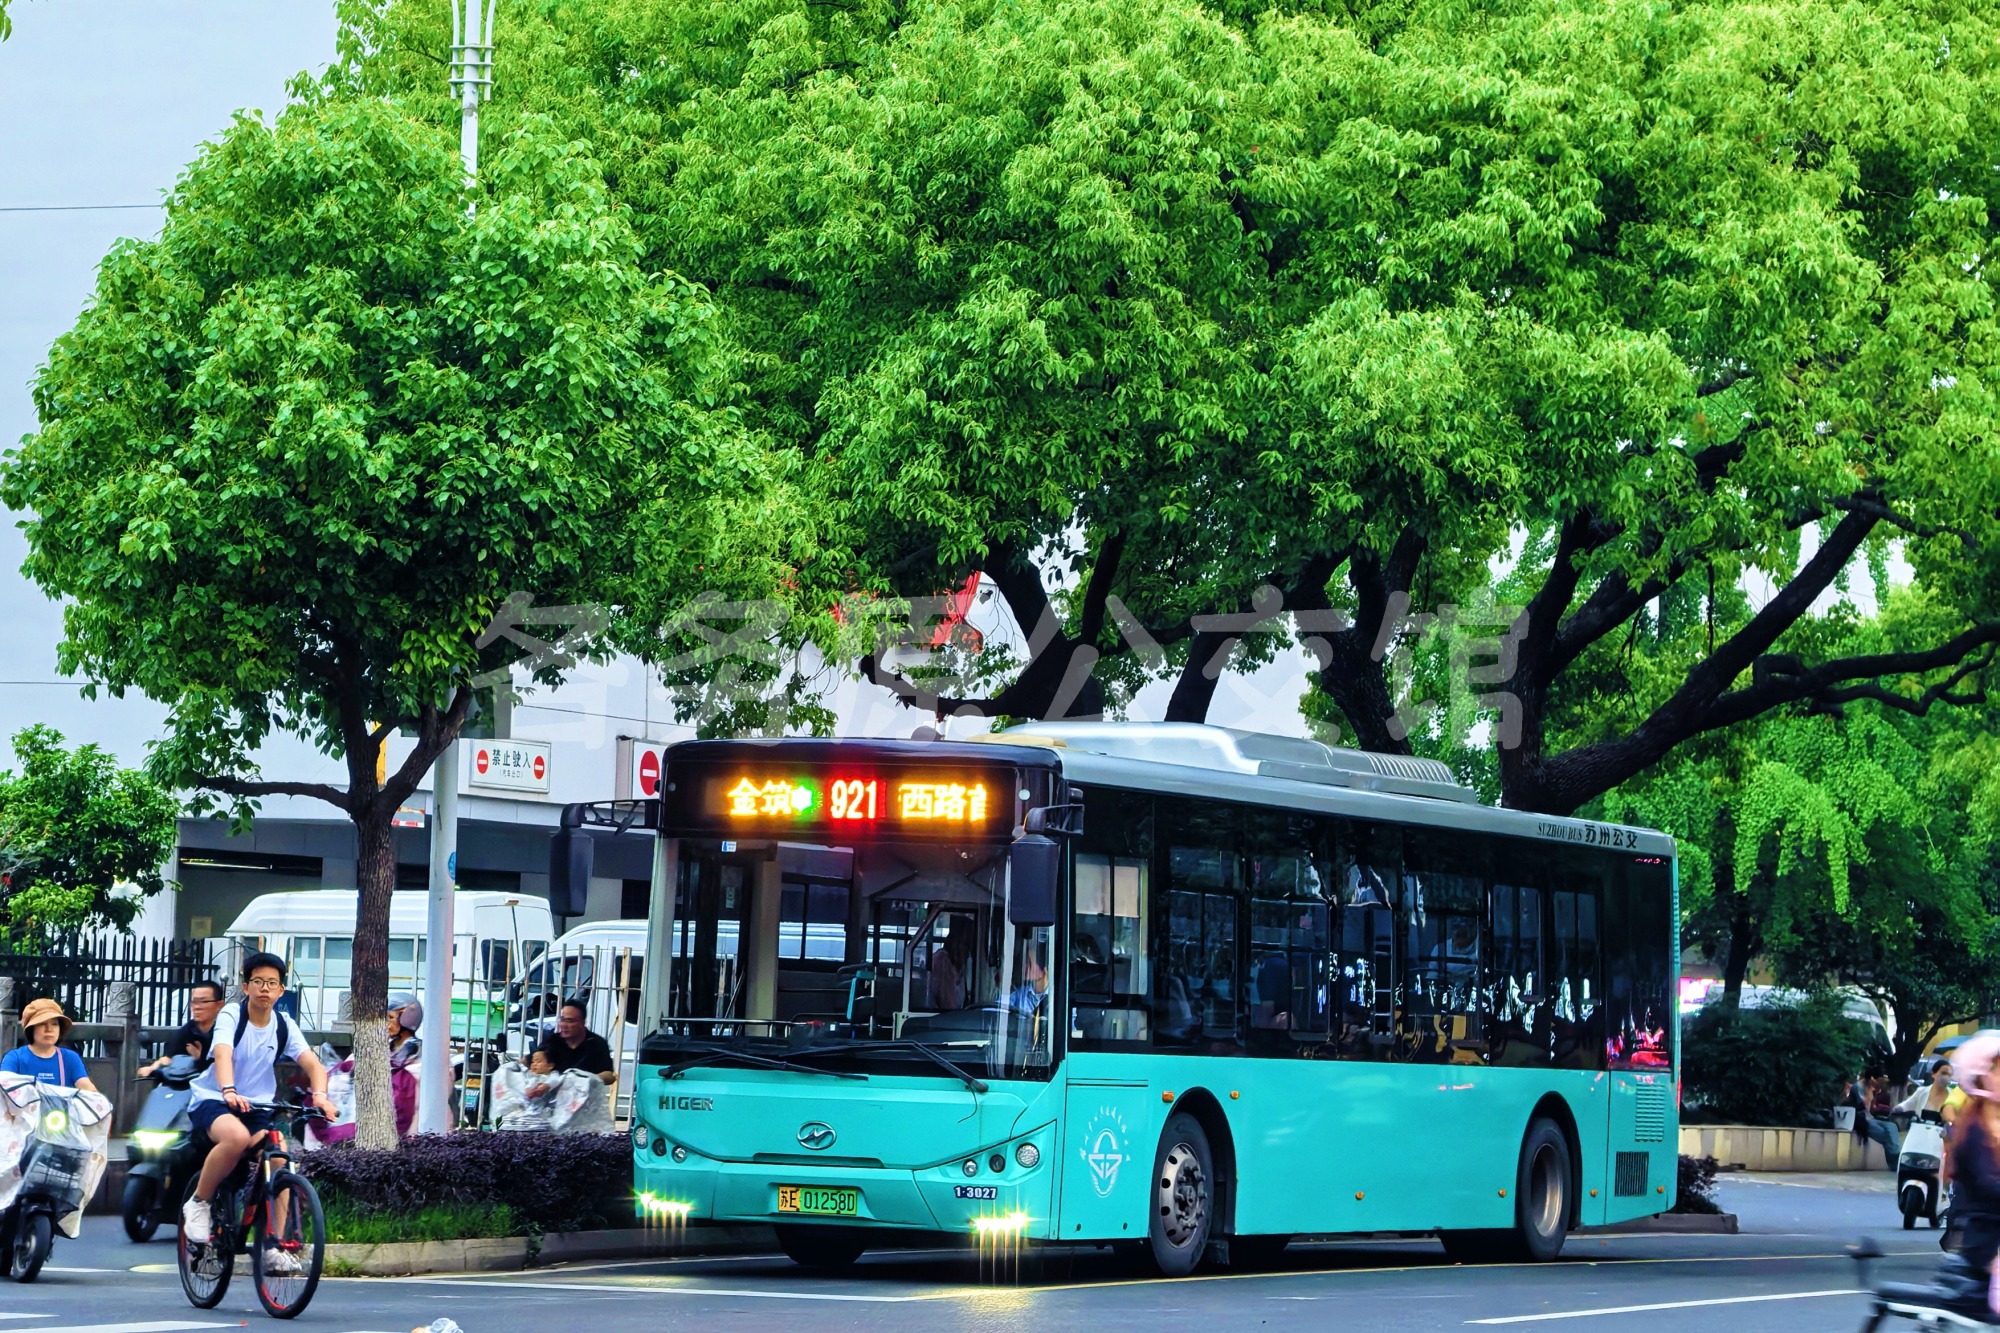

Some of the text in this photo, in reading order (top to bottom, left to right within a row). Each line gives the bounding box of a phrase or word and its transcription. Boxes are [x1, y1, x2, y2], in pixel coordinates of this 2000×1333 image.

[492, 749, 531, 768] 禁止驶入
[831, 780, 876, 819] 921
[1585, 824, 1638, 848] 苏州公交
[658, 1095, 714, 1112] HIGER
